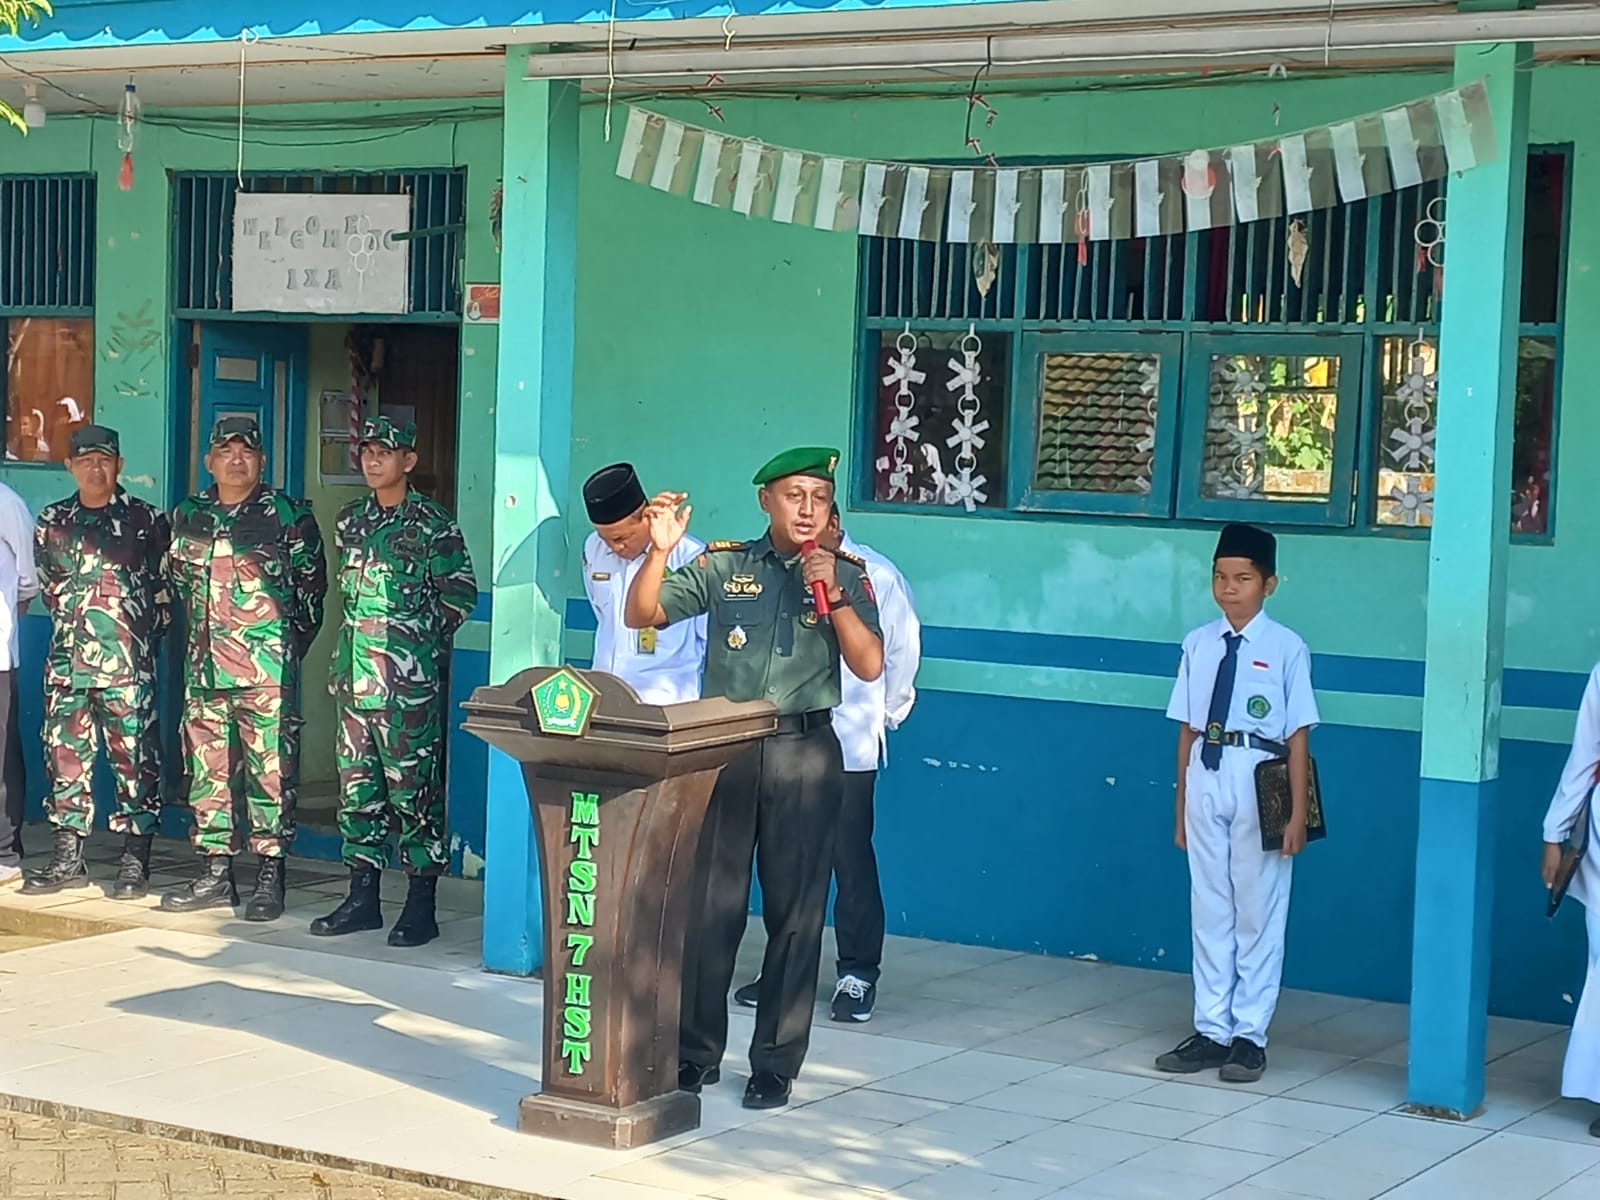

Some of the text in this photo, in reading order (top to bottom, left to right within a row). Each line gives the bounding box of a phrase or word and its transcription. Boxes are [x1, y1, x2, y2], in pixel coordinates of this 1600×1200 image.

[243, 215, 358, 250] WELCOME
[286, 268, 342, 290] IXA
[562, 791, 600, 1074] MTSN 7 HST
